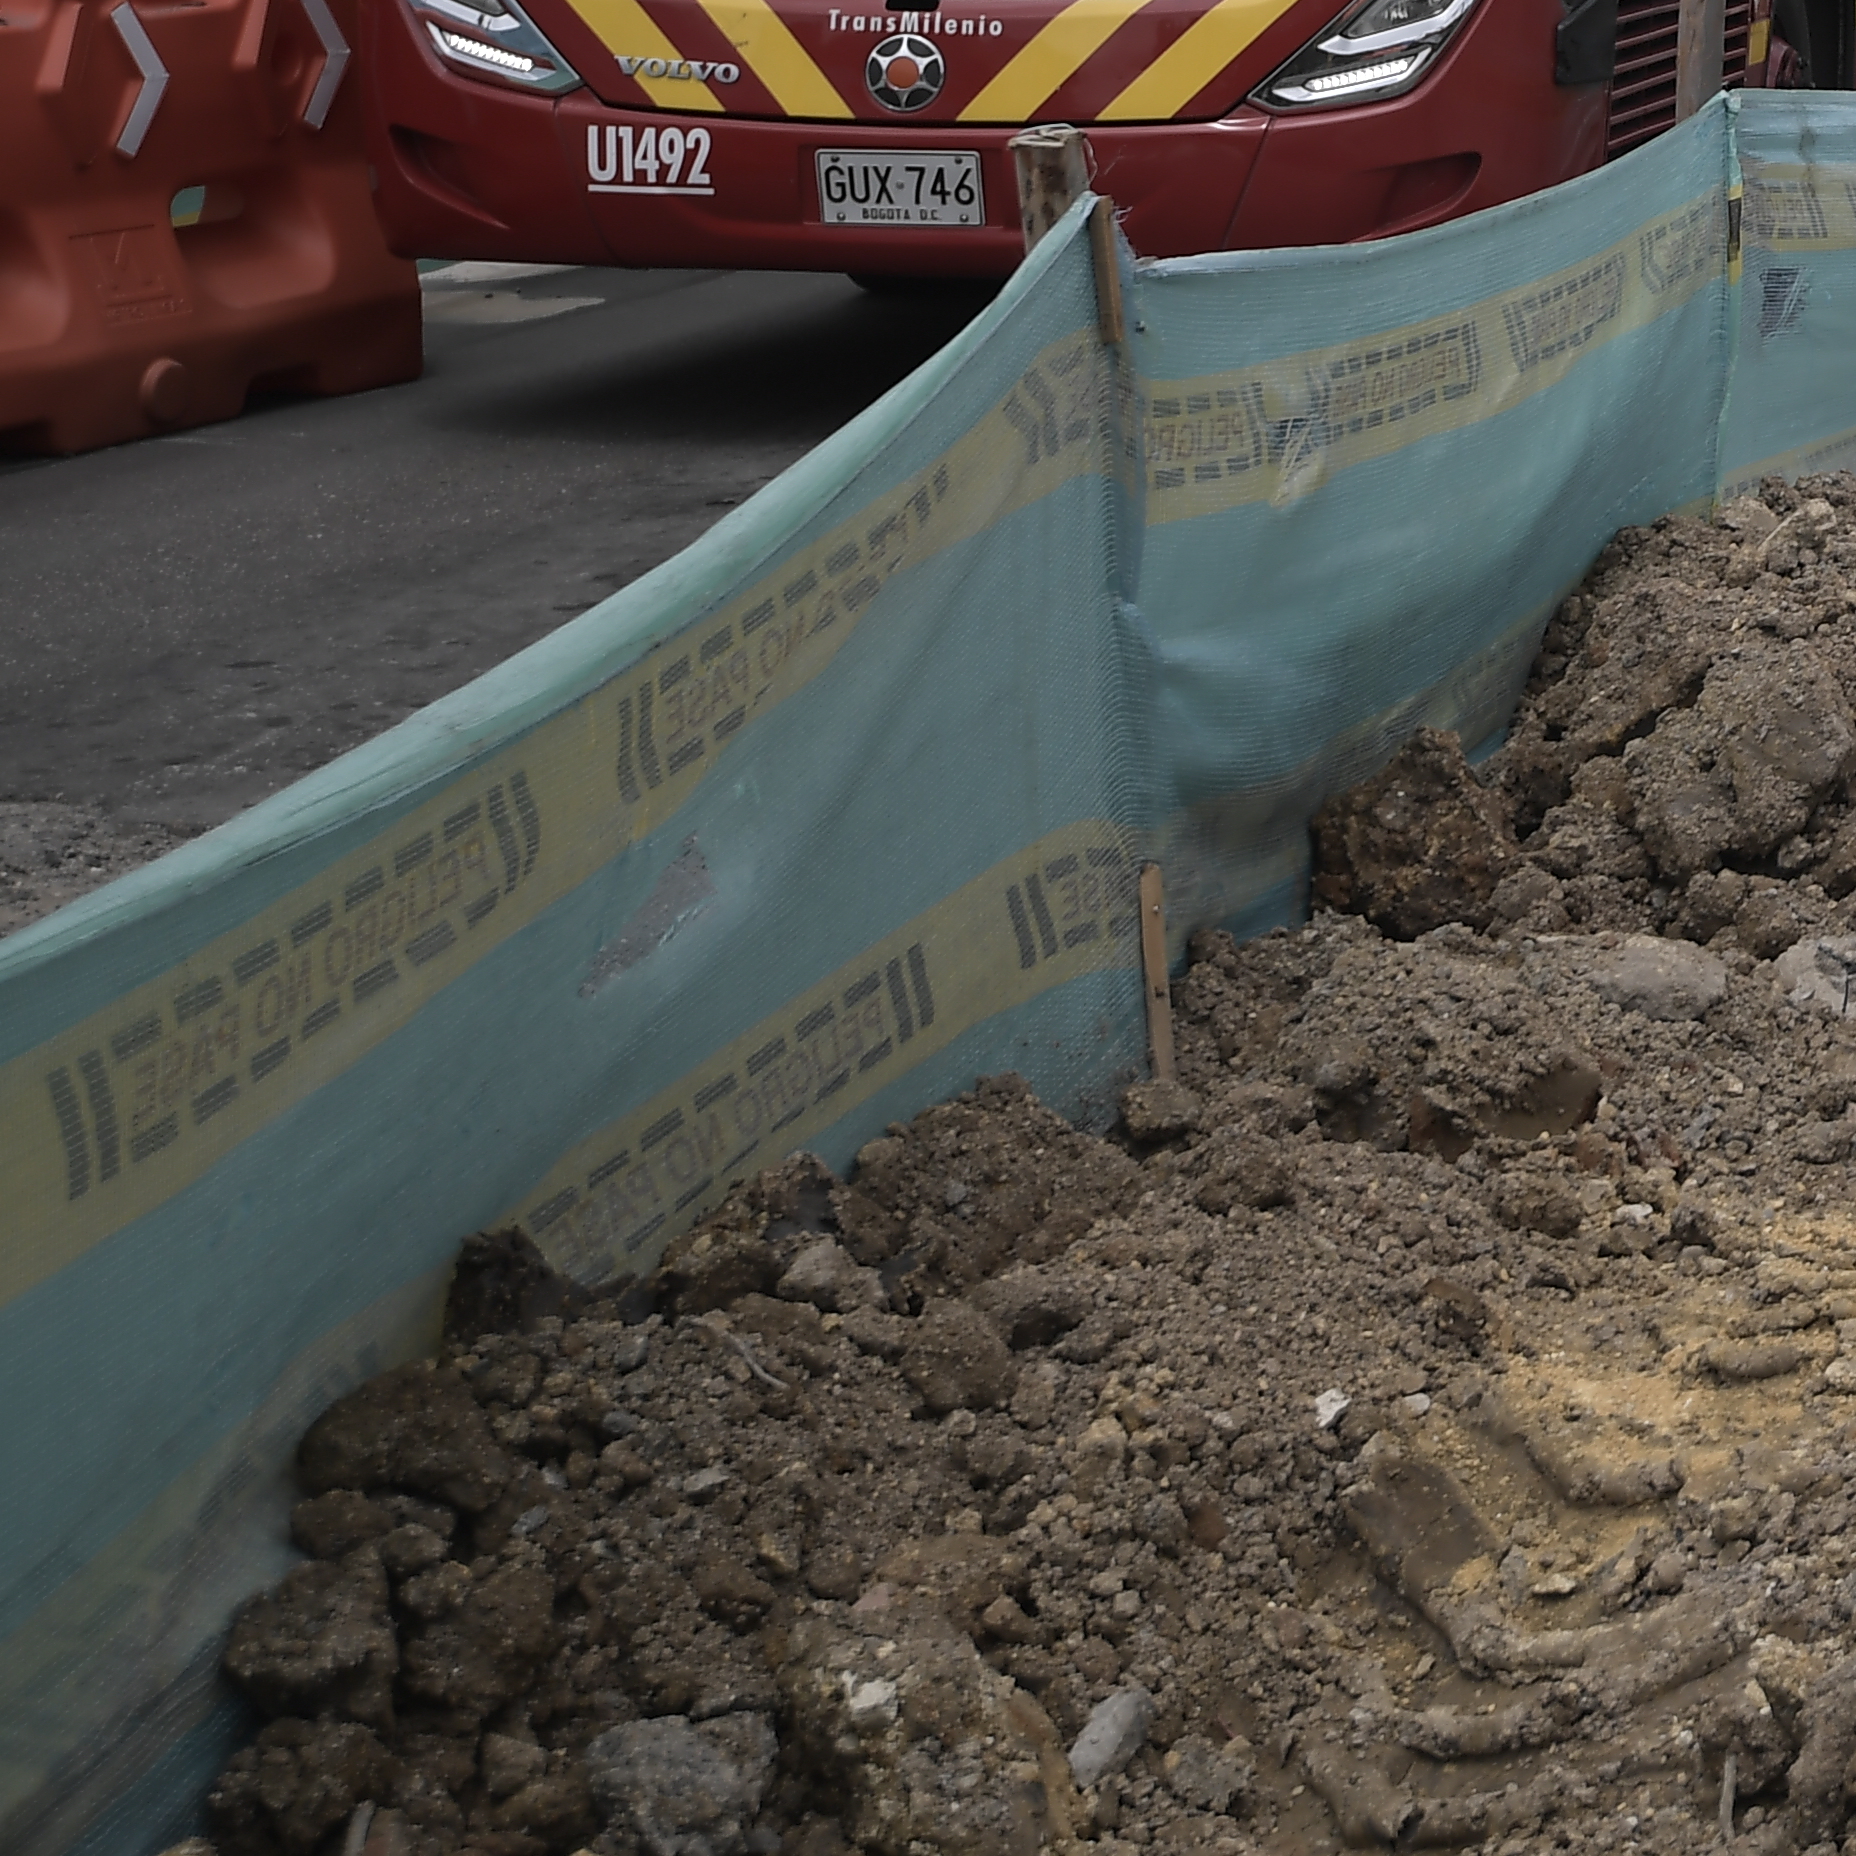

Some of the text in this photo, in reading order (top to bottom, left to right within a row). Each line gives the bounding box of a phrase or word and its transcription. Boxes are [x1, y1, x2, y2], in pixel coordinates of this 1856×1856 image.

[828, 8, 1003, 37] TransMilenio
[613, 54, 740, 84] VOLVO
[587, 124, 712, 185] U1492
[861, 207, 911, 221] BOGOTA
